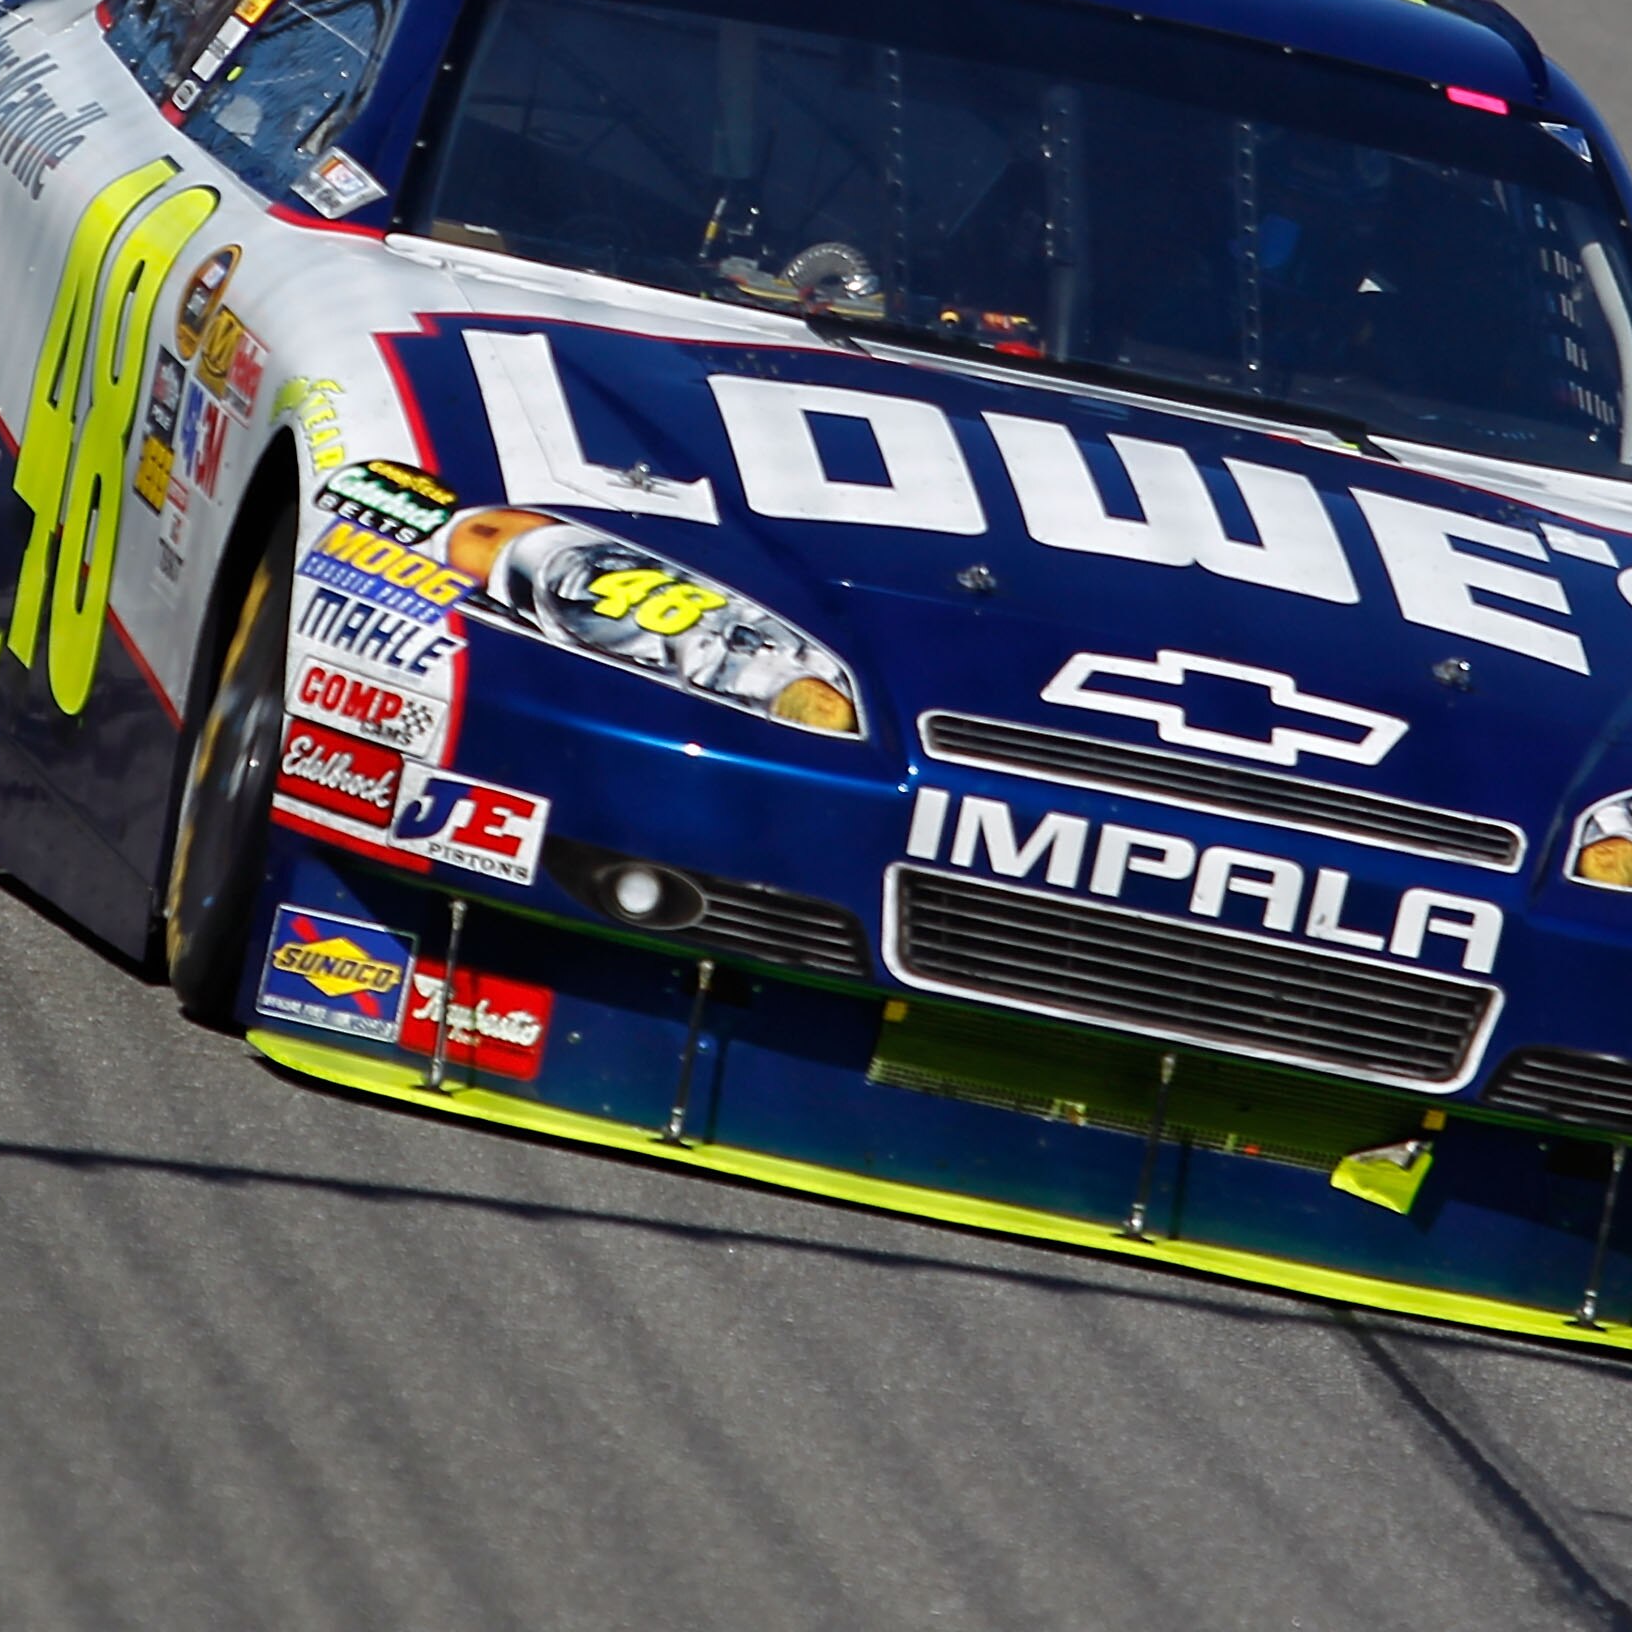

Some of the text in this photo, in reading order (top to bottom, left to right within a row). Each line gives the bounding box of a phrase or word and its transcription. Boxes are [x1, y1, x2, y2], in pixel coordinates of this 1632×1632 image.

[7, 154, 221, 716] 48
[317, 492, 421, 545] BELTS
[315, 521, 476, 607] MOOG
[295, 586, 463, 676] MAHLE
[587, 567, 730, 635] 48
[298, 665, 406, 725] COMP
[360, 720, 412, 745] CAMS
[281, 734, 396, 809] Edelbrock
[394, 777, 537, 858] JE
[427, 841, 531, 882] PISTONS
[906, 786, 1505, 975] IMPALA
[280, 946, 395, 989] SUNOCO
